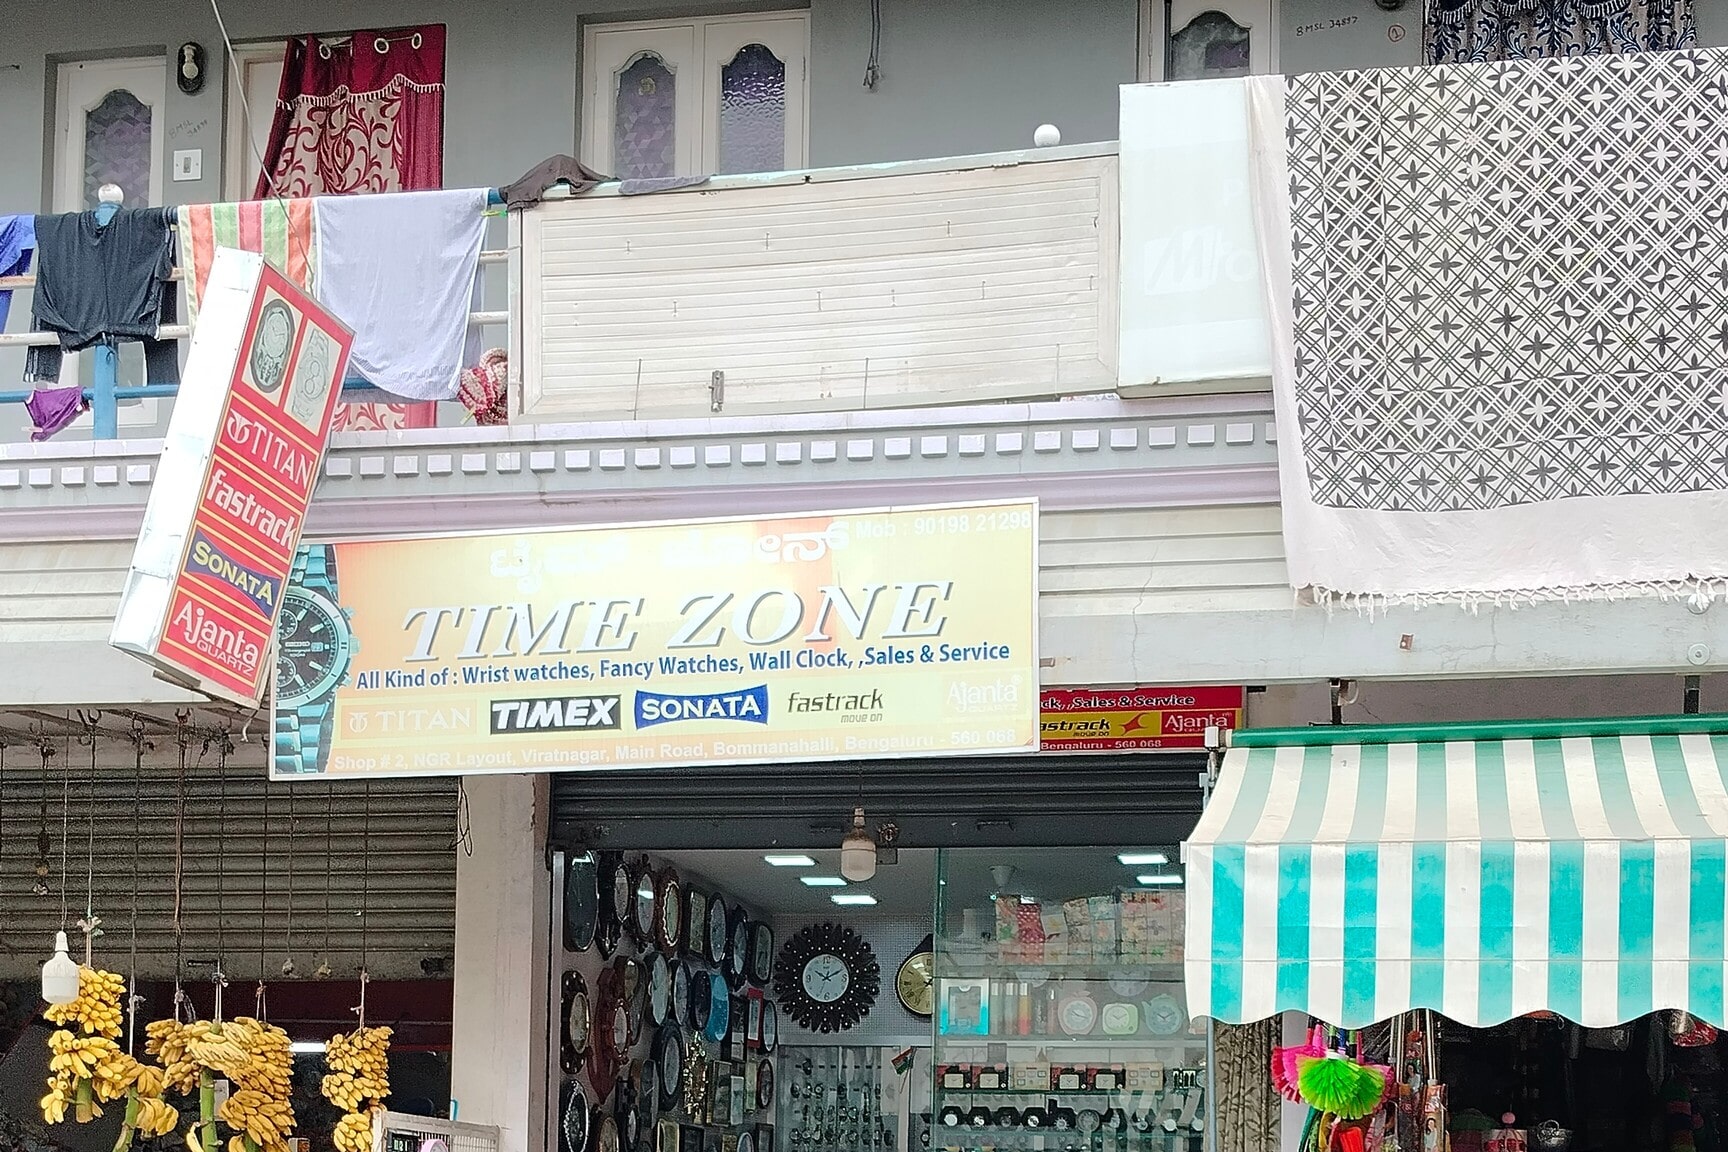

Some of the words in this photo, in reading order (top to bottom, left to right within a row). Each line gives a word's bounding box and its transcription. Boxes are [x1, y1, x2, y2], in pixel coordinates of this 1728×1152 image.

[251, 420, 314, 490] TITAN
[206, 469, 297, 551] fastrack
[855, 520, 897, 538] Mob
[914, 515, 969, 535] 90198
[976, 511, 1032, 532] 21298
[192, 541, 273, 606] SONATA
[172, 600, 259, 667] Ajanta
[404, 597, 645, 662] TIME
[667, 581, 954, 650] ZONE
[196, 638, 254, 676] QUARTZ
[357, 669, 380, 689] All
[385, 669, 424, 688] Kind
[430, 667, 449, 687] of
[462, 664, 509, 685] Wrist
[514, 662, 595, 682] watches,
[600, 659, 654, 680] Fancy
[659, 655, 744, 676] Watches,
[749, 651, 791, 671] Wall
[796, 647, 852, 670] Clock,
[920, 645, 934, 662] &
[939, 641, 1010, 662] Service
[641, 694, 762, 721] SONATA
[788, 688, 884, 714] fastrack
[947, 678, 1018, 712] Ajanta
[1040, 697, 1065, 710] ck,
[1118, 695, 1131, 707] &
[1134, 694, 1195, 706] Service
[375, 707, 472, 732] TITAN
[491, 698, 620, 730] TIMEX
[841, 714, 866, 724] move
[870, 713, 883, 722] on
[1040, 719, 1111, 732] astrack
[1165, 714, 1228, 732] Ajanta
[334, 755, 376, 771] Shop
[395, 754, 408, 769] 2,
[414, 753, 451, 767] NGR
[456, 750, 516, 769] Layout,
[521, 746, 608, 765] Viratnagar,
[616, 745, 654, 760] Main
[660, 742, 708, 758] Road,
[713, 737, 839, 757] Bommanahalli,
[845, 734, 934, 752] Bengaluru
[951, 730, 980, 745] 560
[986, 728, 1017, 743] 068
[1041, 741, 1104, 751] Bengaluru
[1115, 740, 1136, 749] 560
[1139, 739, 1162, 748] 068
